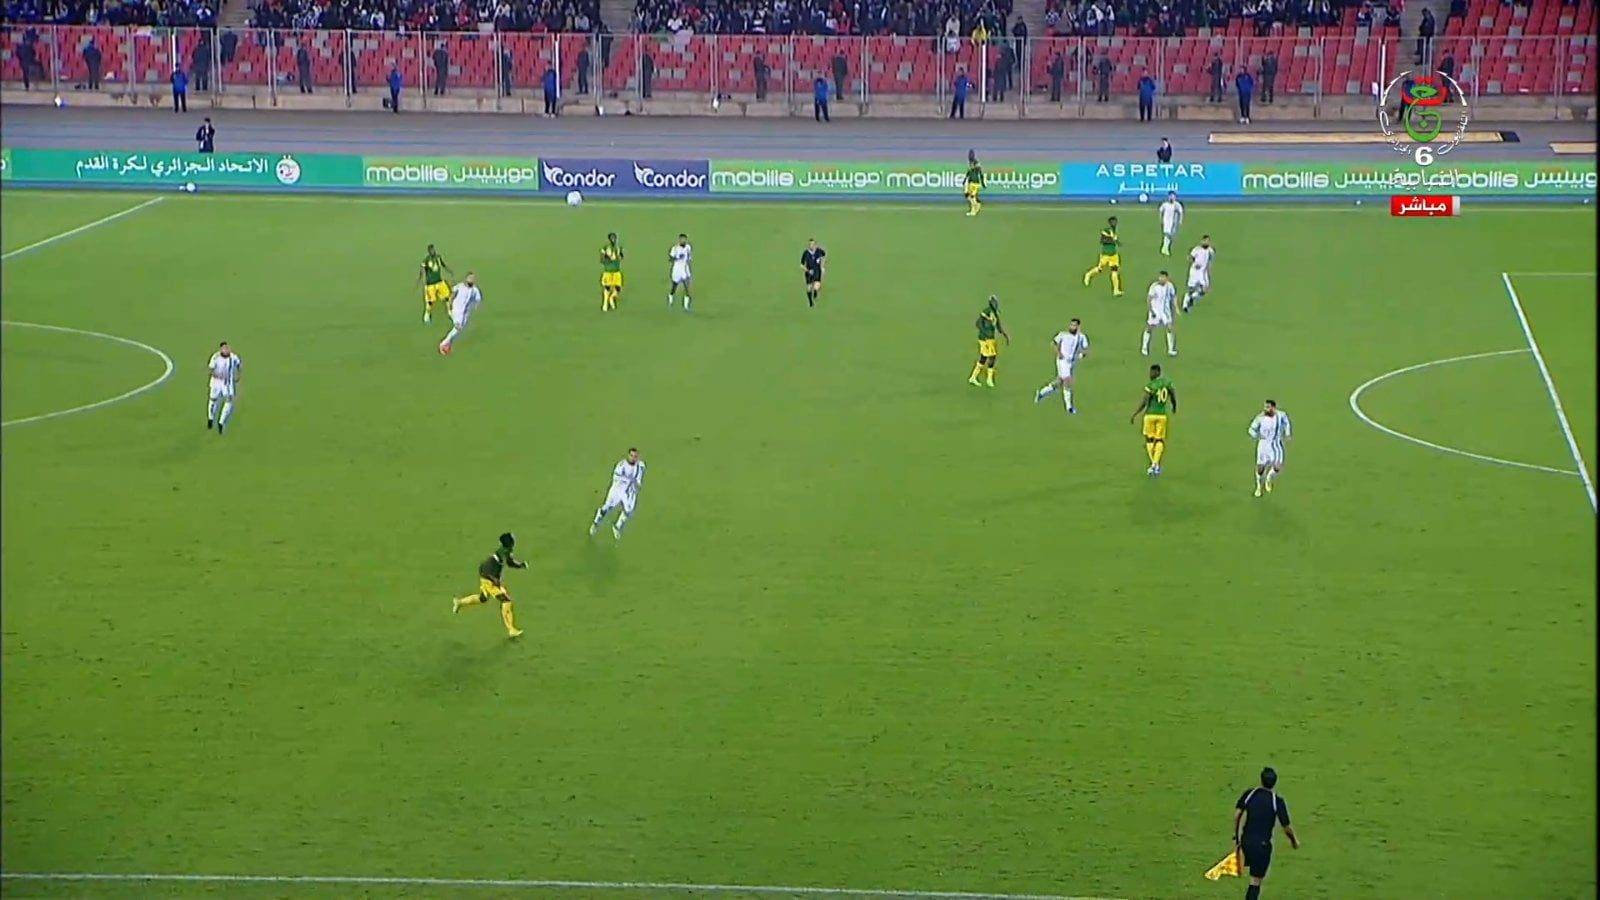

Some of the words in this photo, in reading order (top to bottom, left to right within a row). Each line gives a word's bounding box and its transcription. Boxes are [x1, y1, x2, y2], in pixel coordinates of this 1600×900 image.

[76, 154, 109, 178] القدم
[112, 155, 147, 176] لكرة
[151, 157, 214, 177] الجزائري
[219, 158, 269, 173] الاتحاد
[453, 164, 535, 184] موبيليس
[1096, 163, 1206, 180] ASPETAR
[552, 166, 616, 187] Condor
[643, 167, 707, 188] Condor
[799, 169, 881, 188] موبيليس
[1156, 387, 1168, 402] 10
